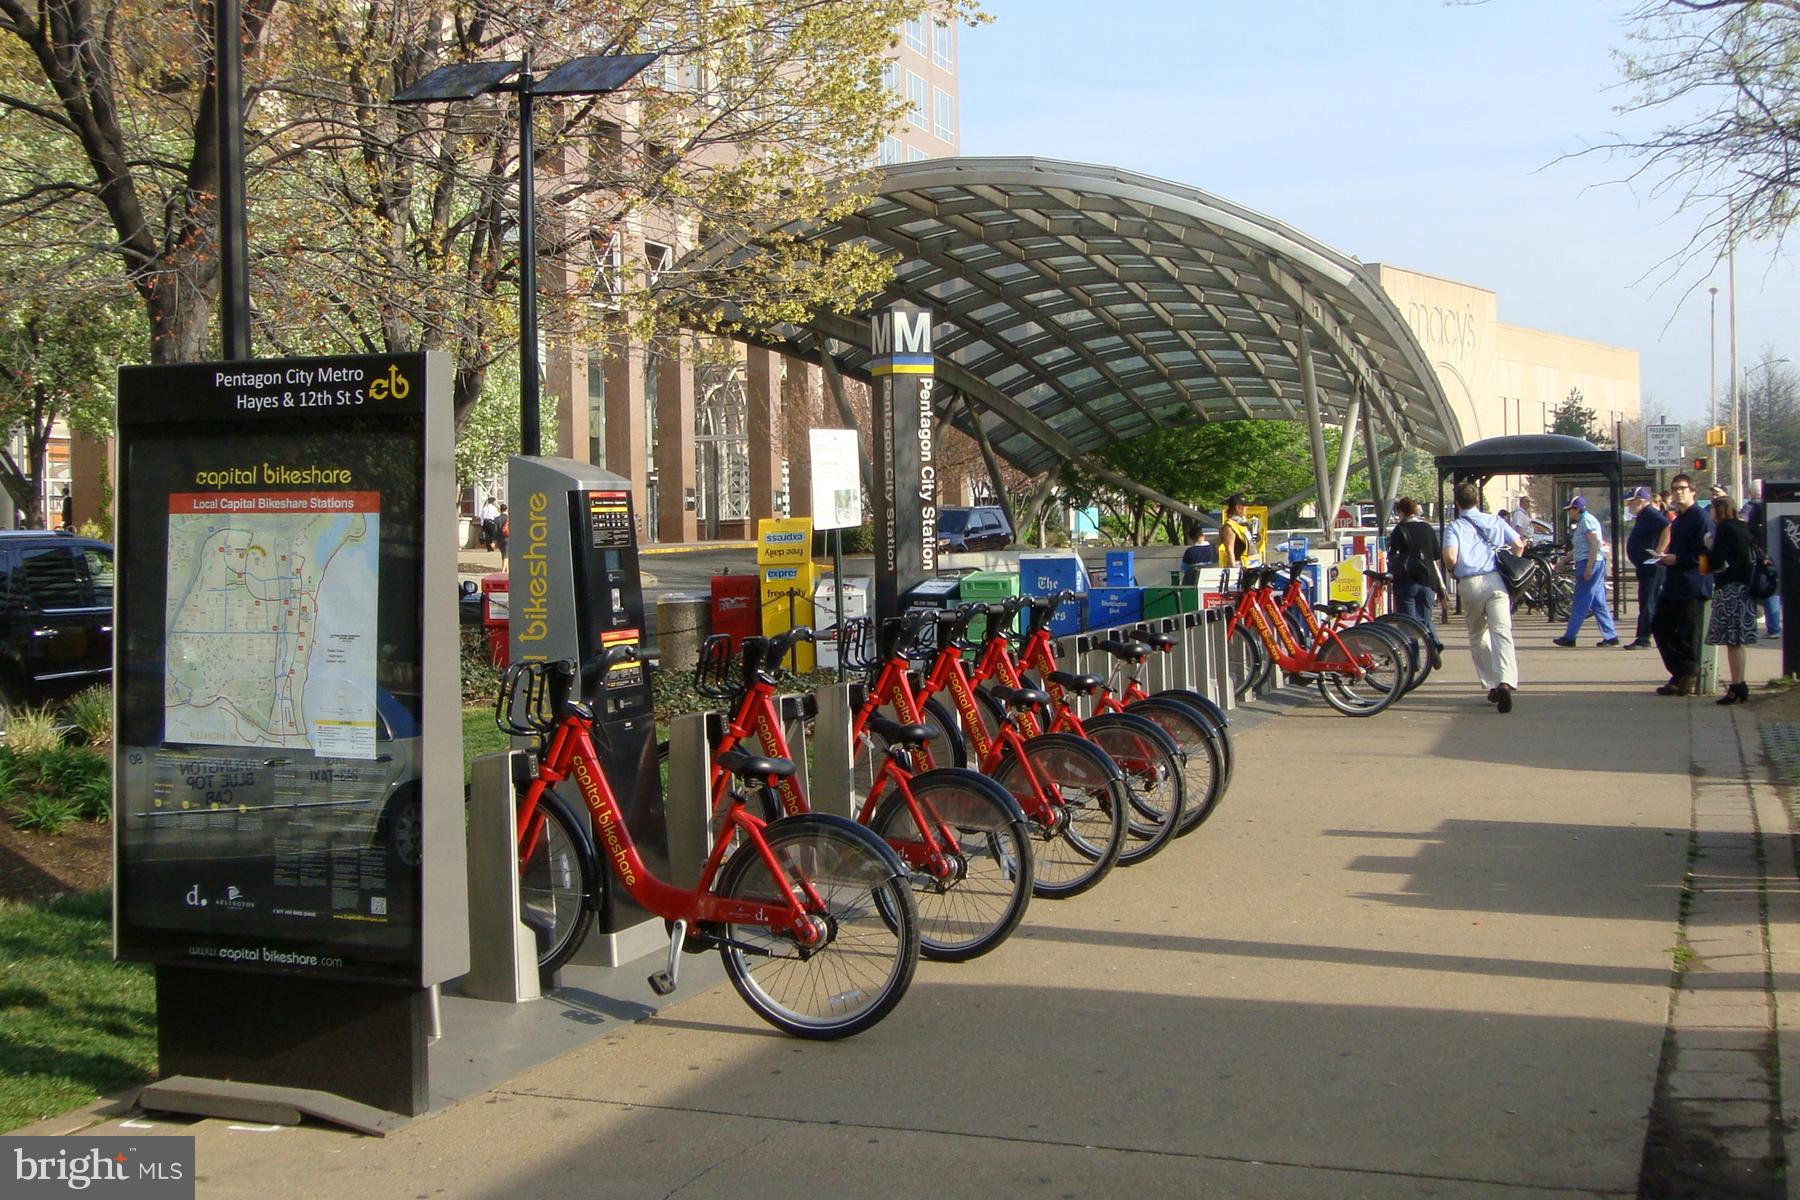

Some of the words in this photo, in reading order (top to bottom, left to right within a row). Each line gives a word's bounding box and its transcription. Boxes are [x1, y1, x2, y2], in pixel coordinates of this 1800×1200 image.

[871, 315, 890, 355] M
[894, 312, 930, 353] M
[1409, 301, 1475, 360] macy's
[216, 371, 281, 389] Pentagon
[286, 369, 314, 386] City
[318, 367, 363, 383] Metro
[237, 393, 278, 412] Hayes
[283, 392, 295, 408] &
[299, 390, 332, 407] 12th
[336, 390, 351, 405] St
[355, 389, 363, 405] S
[883, 378, 893, 463] Pentagon
[918, 378, 933, 462] Pentagon
[196, 466, 257, 490] capital
[263, 462, 352, 484] bikeshare
[884, 467, 894, 502] City
[918, 466, 935, 500] City
[193, 498, 218, 510] Local
[220, 497, 256, 511] Capital
[258, 497, 308, 509] Bikeshare
[310, 497, 354, 509] Stations
[766, 532, 803, 543] express
[921, 506, 936, 570] Station
[1334, 517, 1353, 528] TOP
[764, 547, 785, 558] daily
[786, 548, 803, 557] free
[886, 506, 895, 571] Station
[518, 492, 547, 642] bikeshare
[1037, 576, 1059, 591] The
[997, 662, 1014, 688] capit
[949, 672, 972, 710] capital
[573, 756, 606, 810] capital
[599, 808, 636, 887] bikeshare
[186, 884, 208, 906] d.
[755, 907, 769, 922] d.
